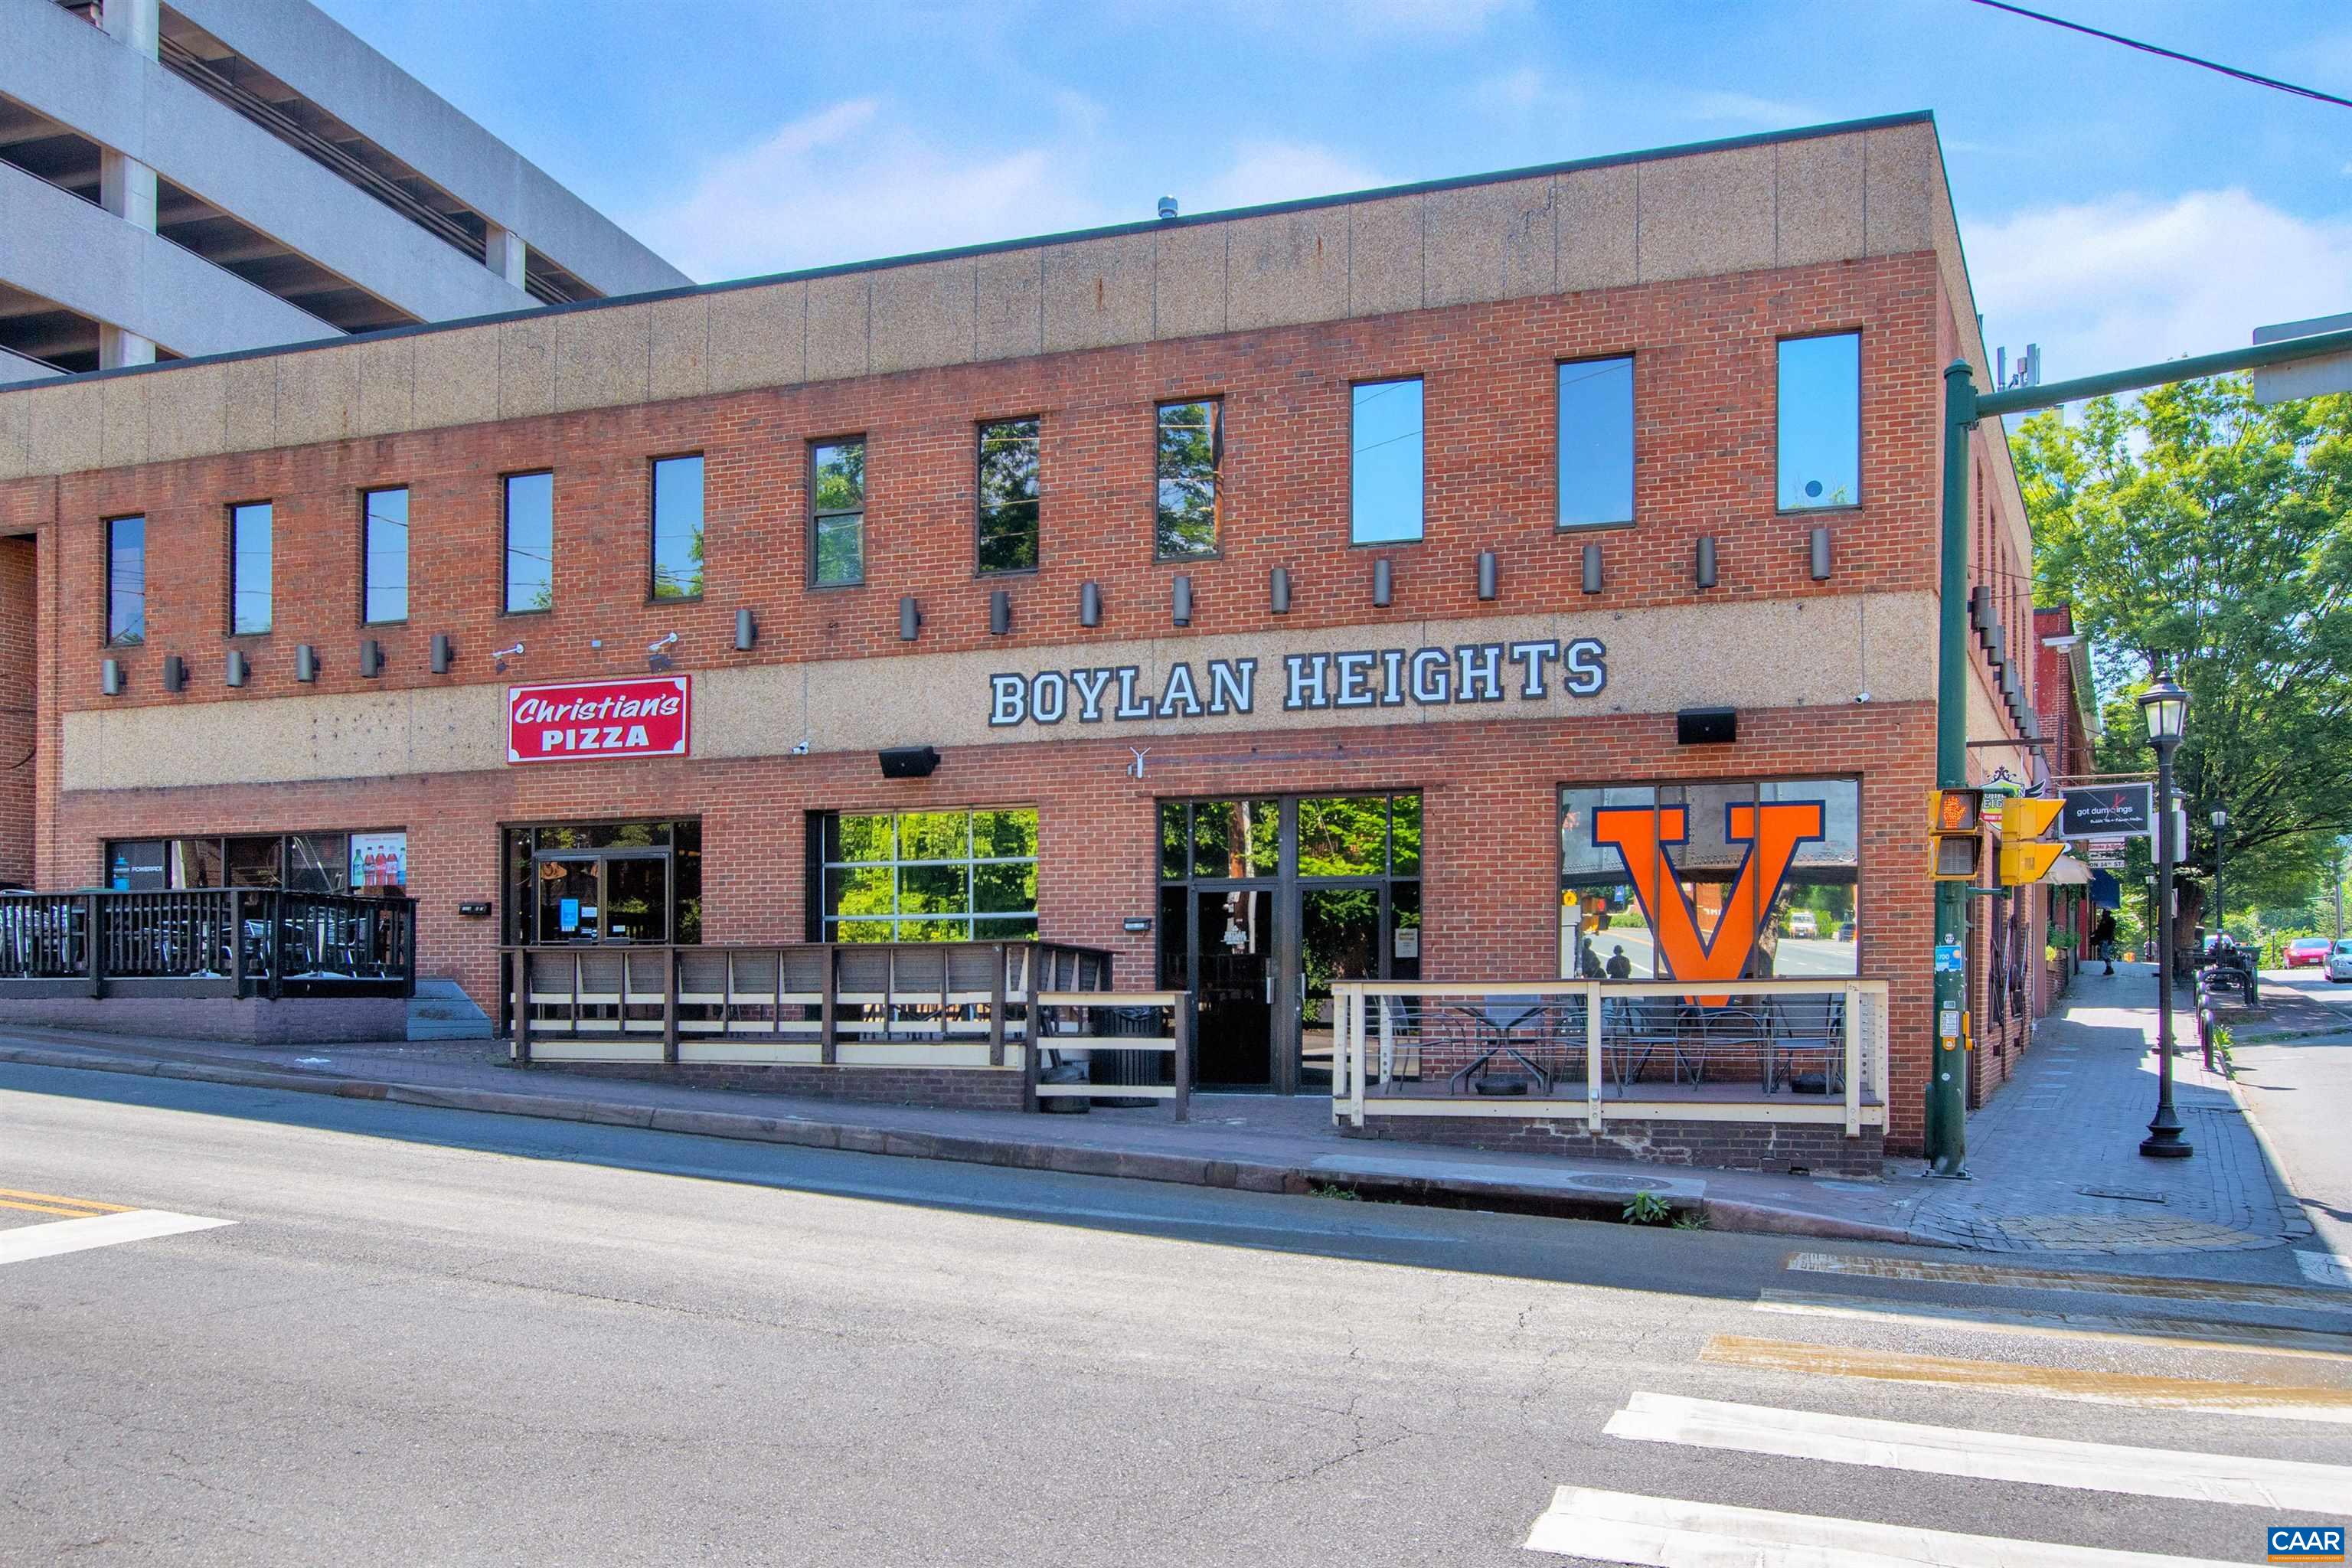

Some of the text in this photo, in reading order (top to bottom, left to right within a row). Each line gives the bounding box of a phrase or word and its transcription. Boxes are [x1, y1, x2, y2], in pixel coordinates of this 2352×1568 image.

[988, 638, 1608, 728] BOYLAN HEIGHTS
[514, 694, 681, 724] Christian's
[541, 725, 650, 752] PIZZA
[2076, 808, 2090, 817] got
[1592, 800, 1826, 1012] V
